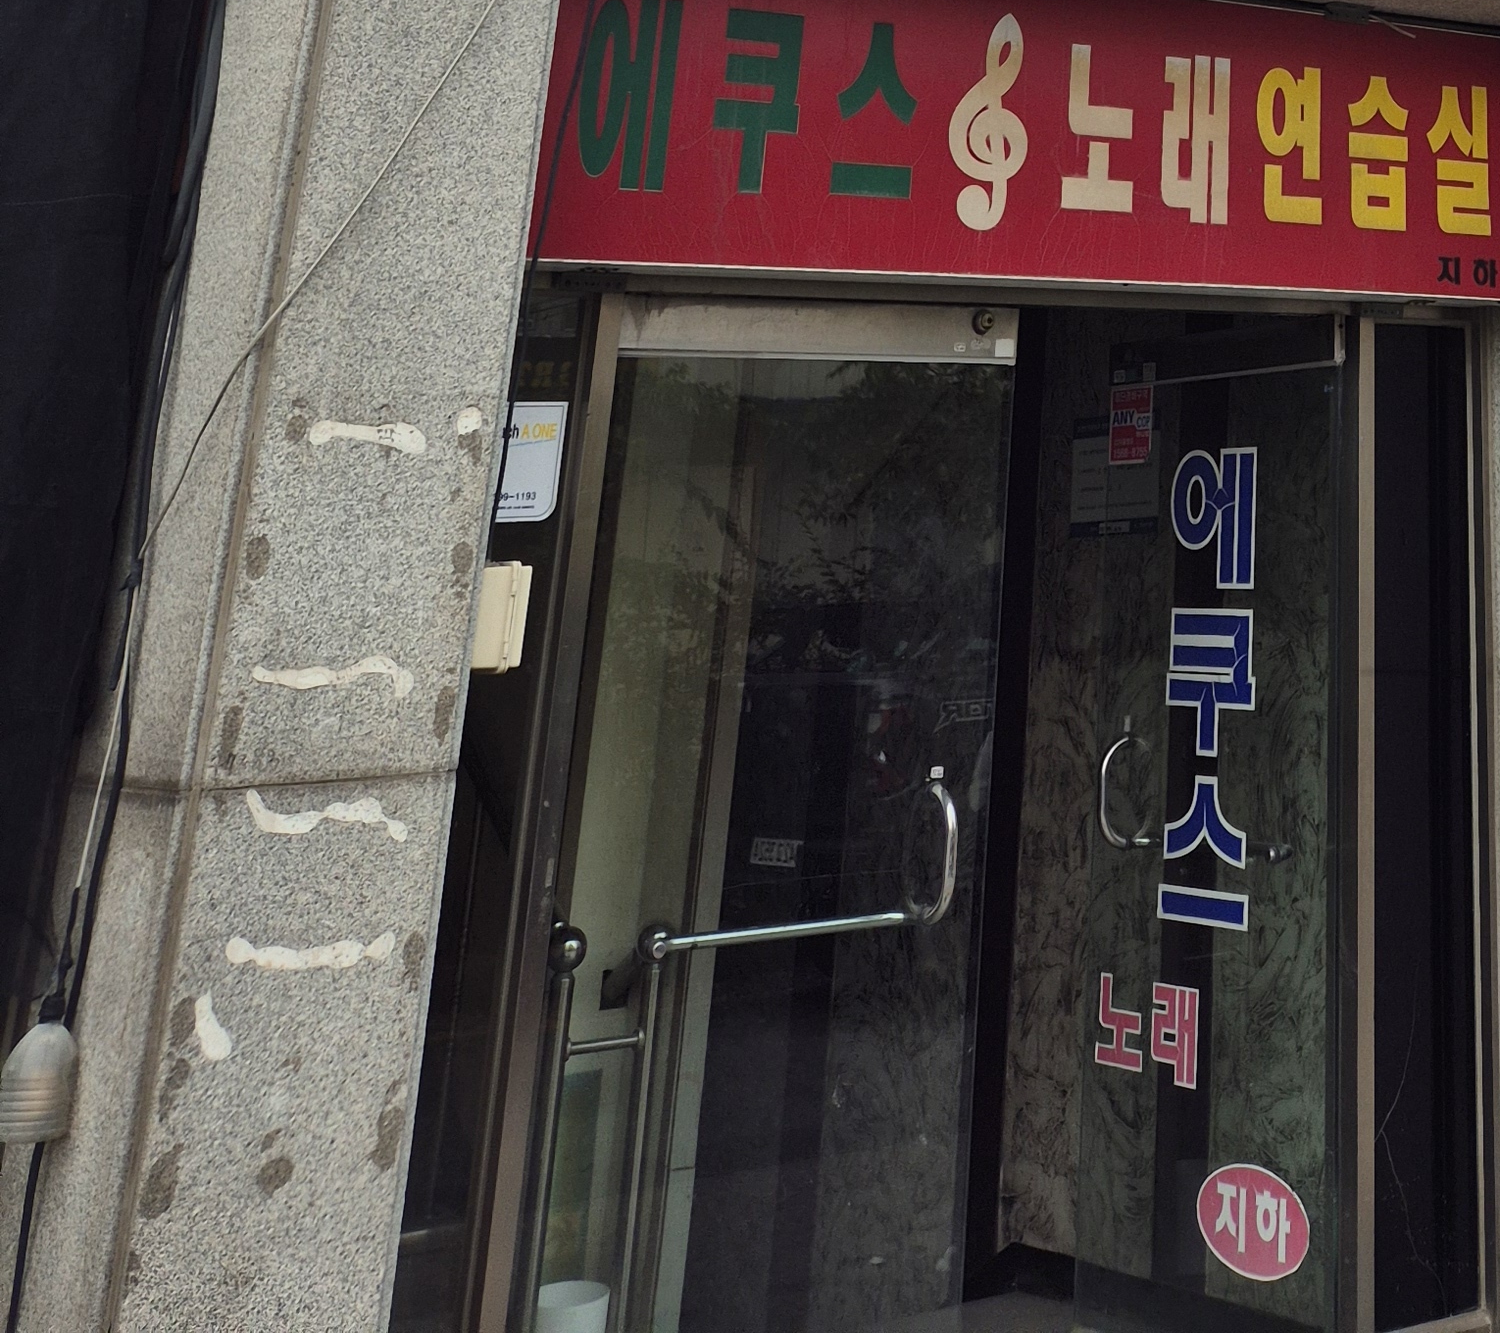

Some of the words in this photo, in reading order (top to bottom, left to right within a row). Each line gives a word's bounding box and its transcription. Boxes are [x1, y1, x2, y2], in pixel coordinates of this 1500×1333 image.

[1437, 256, 1498, 288] 지하
[532, 423, 557, 439] ONE
[1112, 411, 1136, 426] ANY
[1157, 445, 1258, 932] 에쿠스
[1094, 972, 1199, 1090] 노래
[1214, 1182, 1291, 1265] 지하
